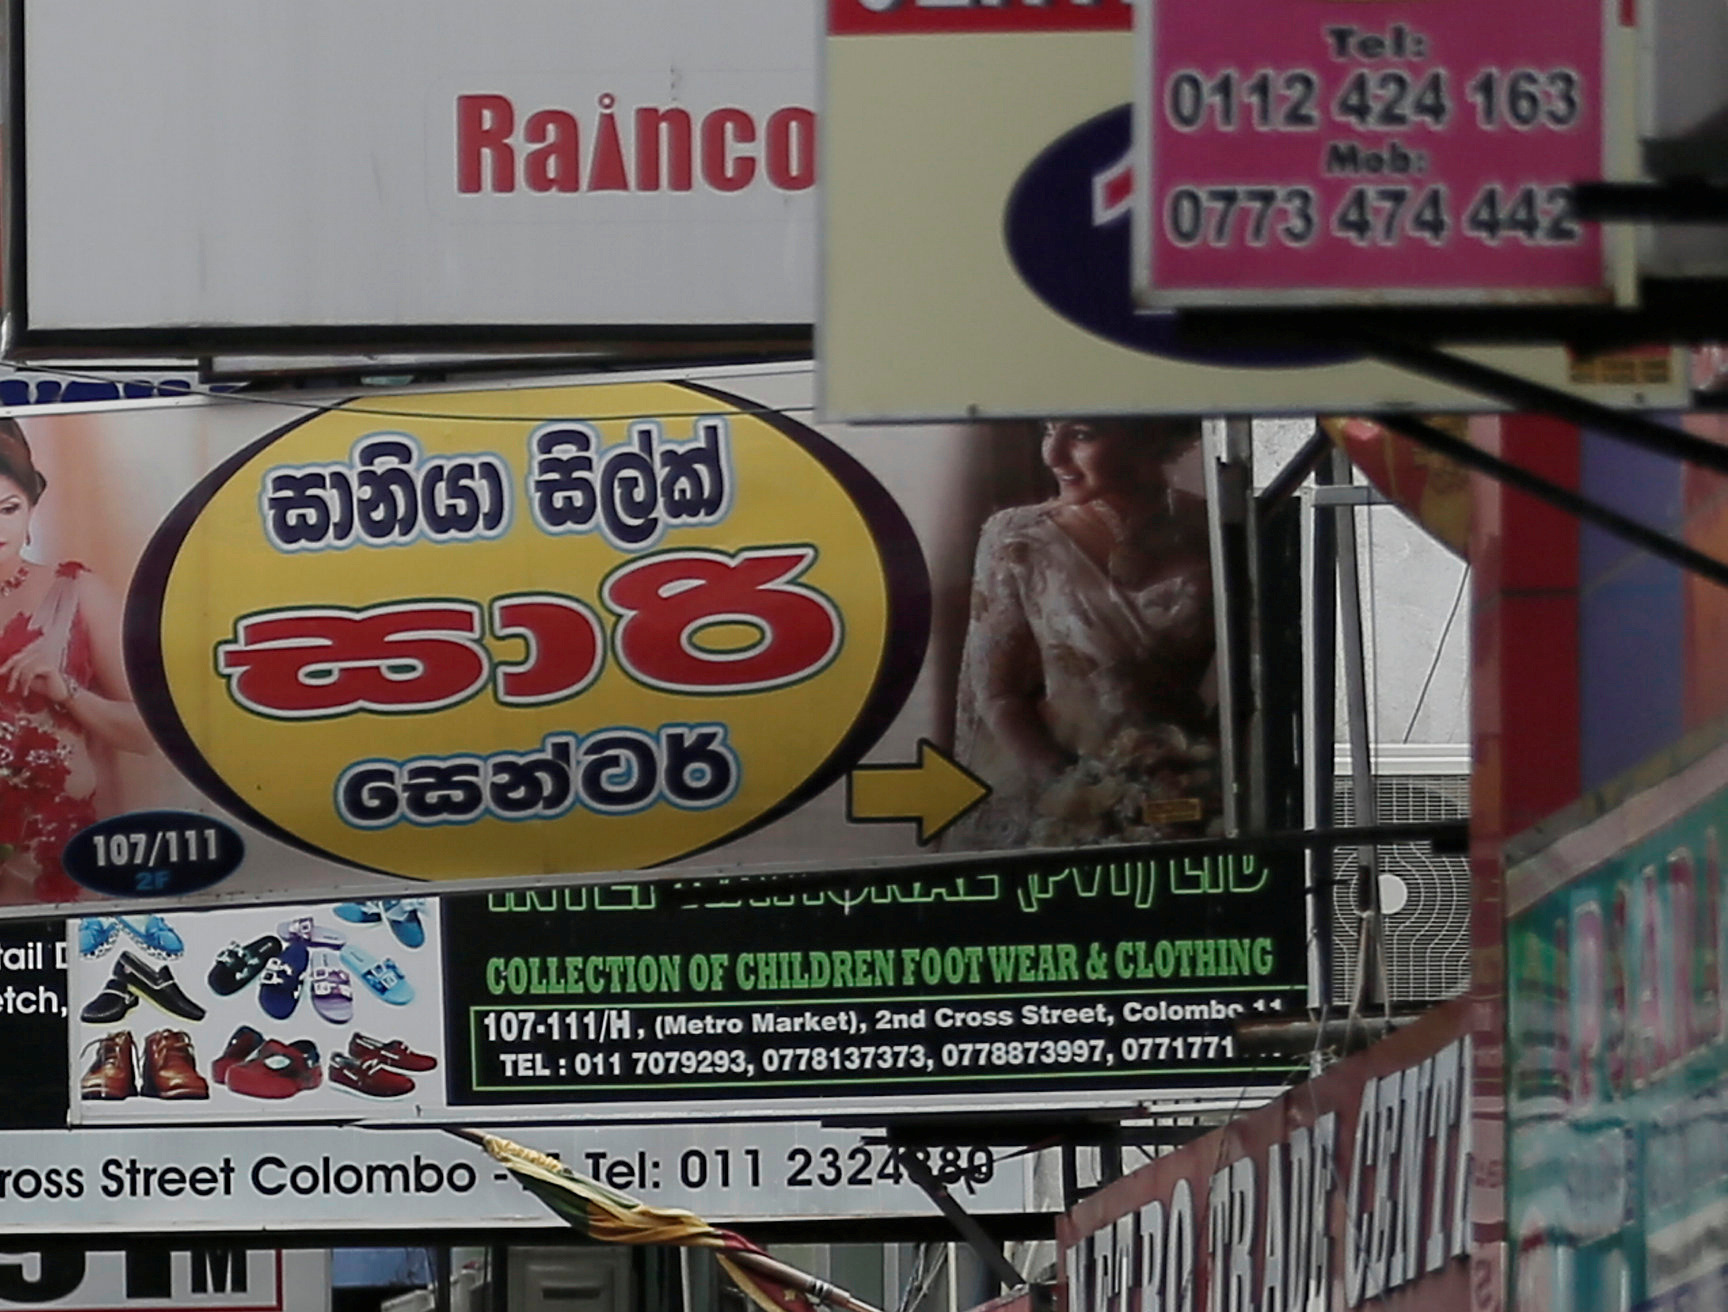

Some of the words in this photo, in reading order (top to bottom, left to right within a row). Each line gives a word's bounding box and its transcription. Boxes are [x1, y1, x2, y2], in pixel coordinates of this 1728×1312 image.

[1327, 25, 1427, 62] Tel:
[1168, 69, 1319, 131] 0112
[1342, 69, 1447, 130] 424
[1470, 69, 1580, 129] 163
[1324, 141, 1427, 175] Mob:
[1168, 188, 1314, 246] 0773
[1342, 188, 1447, 245] 474
[1469, 188, 1580, 245] 442
[92, 828, 217, 867] 107/111
[486, 955, 681, 995] COLLECTION
[689, 954, 728, 992] OF
[736, 949, 895, 991] CHILDREN
[1085, 941, 1108, 980] &
[1115, 937, 1273, 979] CLOTHING
[655, 1013, 743, 1039] (Metro
[752, 1010, 867, 1036] Market),
[875, 1007, 926, 1030] 2nd
[934, 1006, 1013, 1028] Cross
[1021, 1002, 1114, 1028] Street,
[575, 1051, 621, 1076] 011
[632, 1049, 755, 1078] 7079293,
[763, 1044, 934, 1073] 0778137373,
[942, 1038, 1114, 1076] 0778873997,
[99, 1155, 235, 1199] Street
[251, 1150, 477, 1196] Colombo
[586, 1150, 660, 1190] Tel:
[679, 1146, 762, 1189] 011
